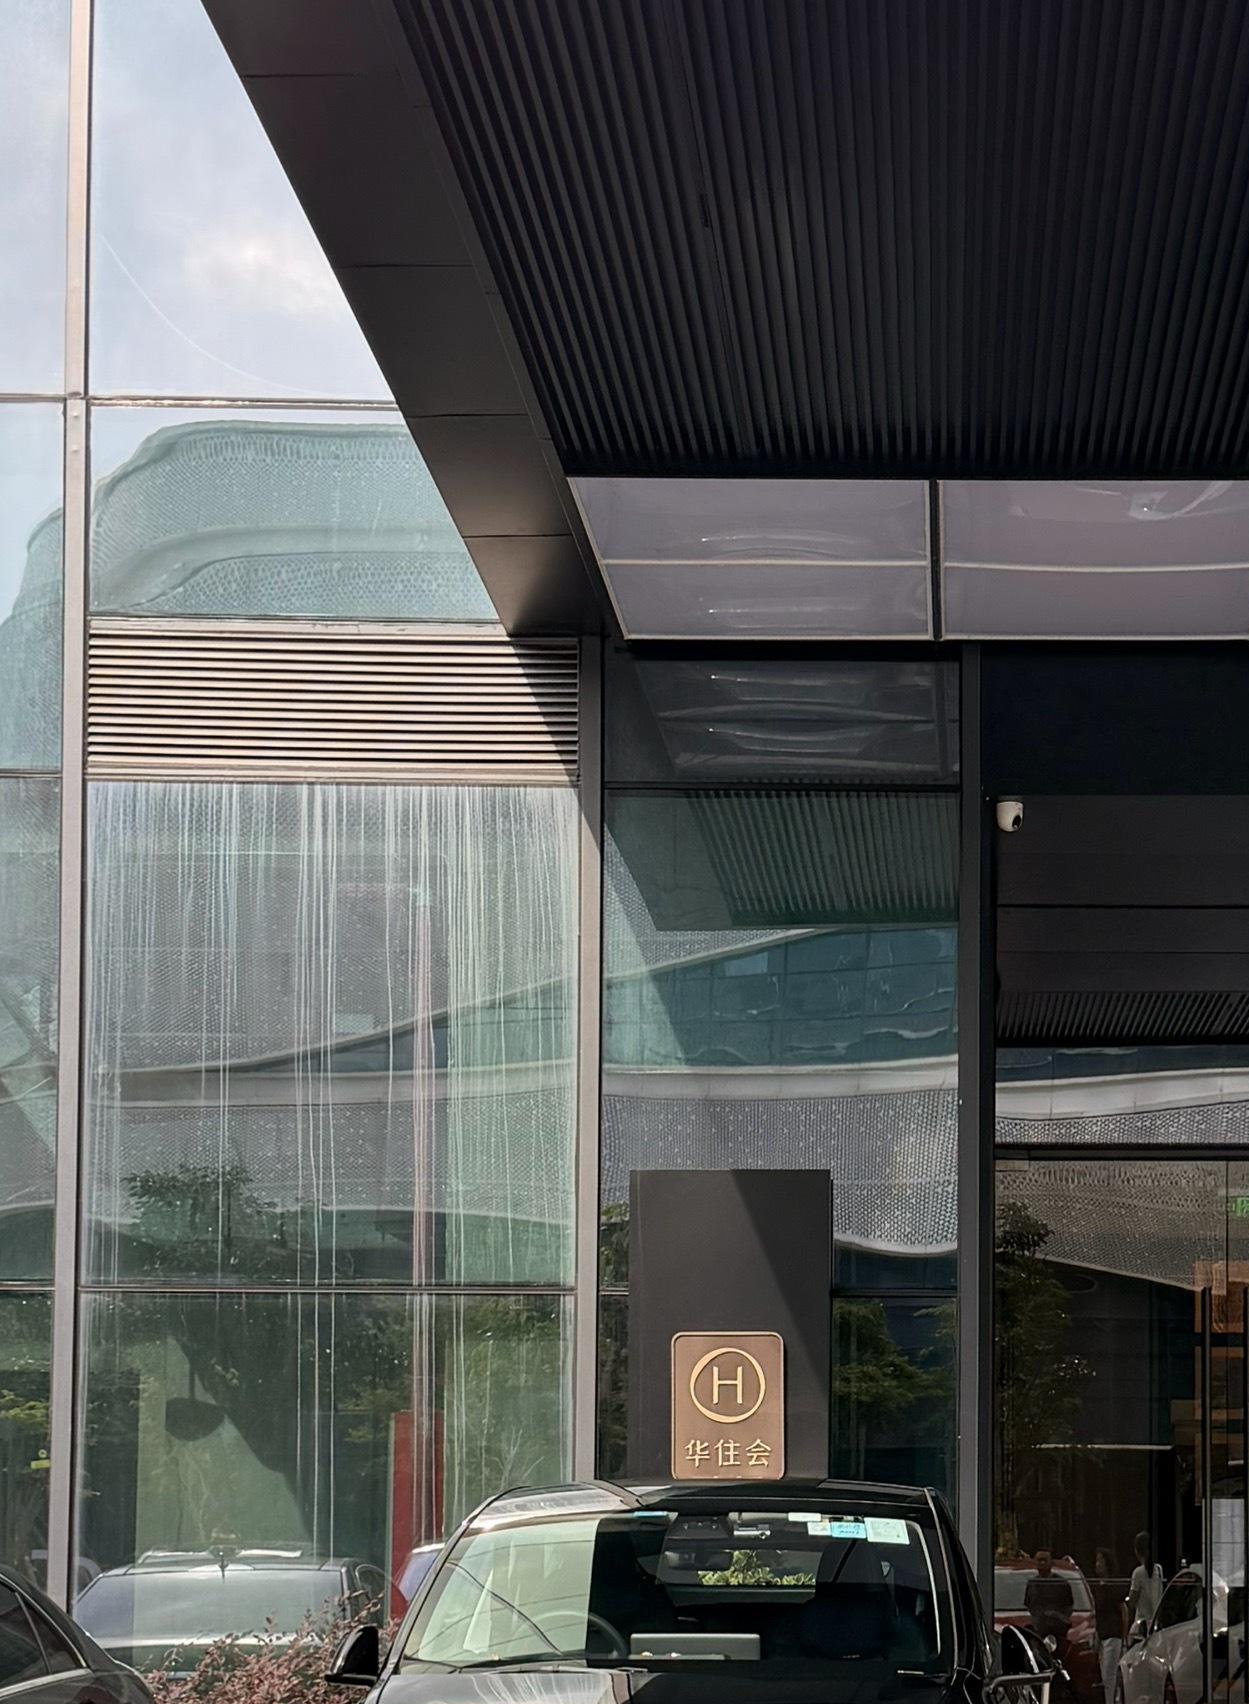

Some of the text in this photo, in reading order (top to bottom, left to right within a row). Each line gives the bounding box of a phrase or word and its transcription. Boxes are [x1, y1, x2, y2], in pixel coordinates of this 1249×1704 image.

[711, 1365, 744, 1405] H
[685, 1438, 772, 1468] 华住会
